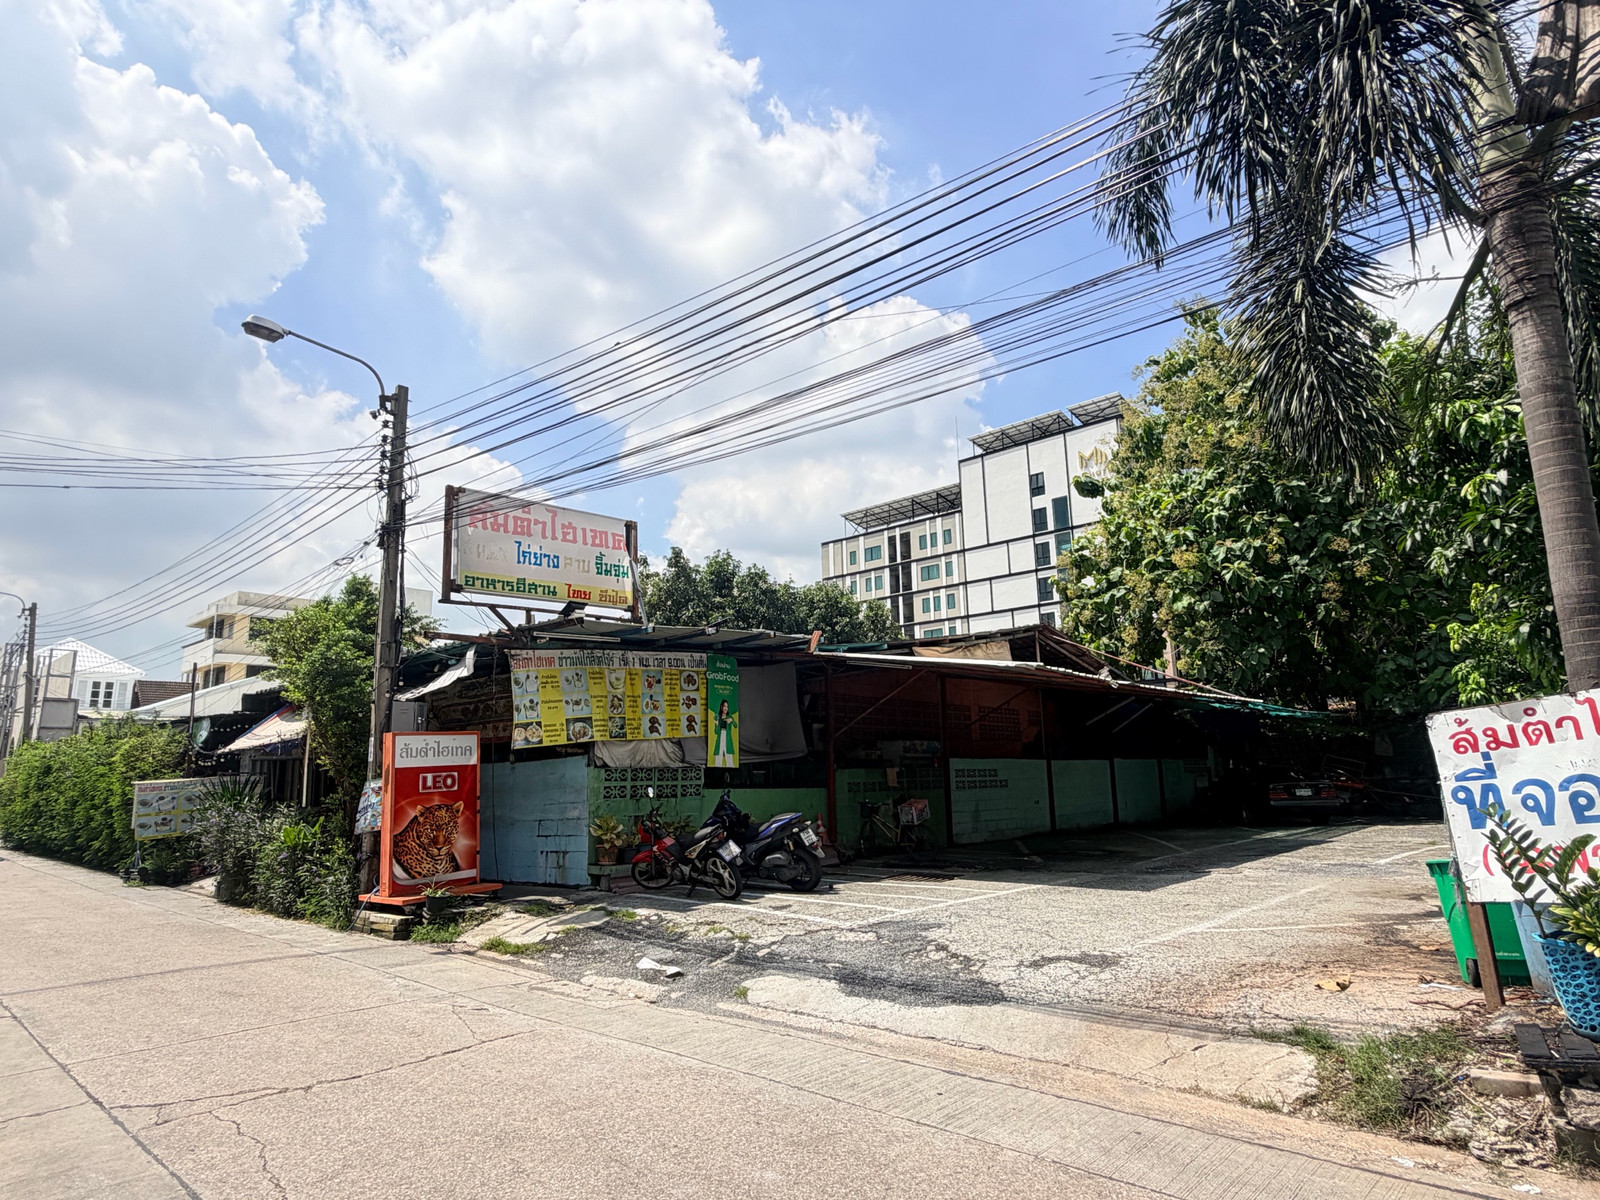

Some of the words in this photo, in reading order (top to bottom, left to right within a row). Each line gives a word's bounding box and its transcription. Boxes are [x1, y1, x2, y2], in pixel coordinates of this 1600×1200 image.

[514, 541, 560, 569] ไก่ย่าง
[464, 574, 558, 596] อาหารอีสาน
[565, 583, 591, 600] ไทย
[706, 671, 739, 683] GrabFood
[400, 740, 473, 759] ส้มตำไฮเทค
[421, 773, 457, 791] LEO
